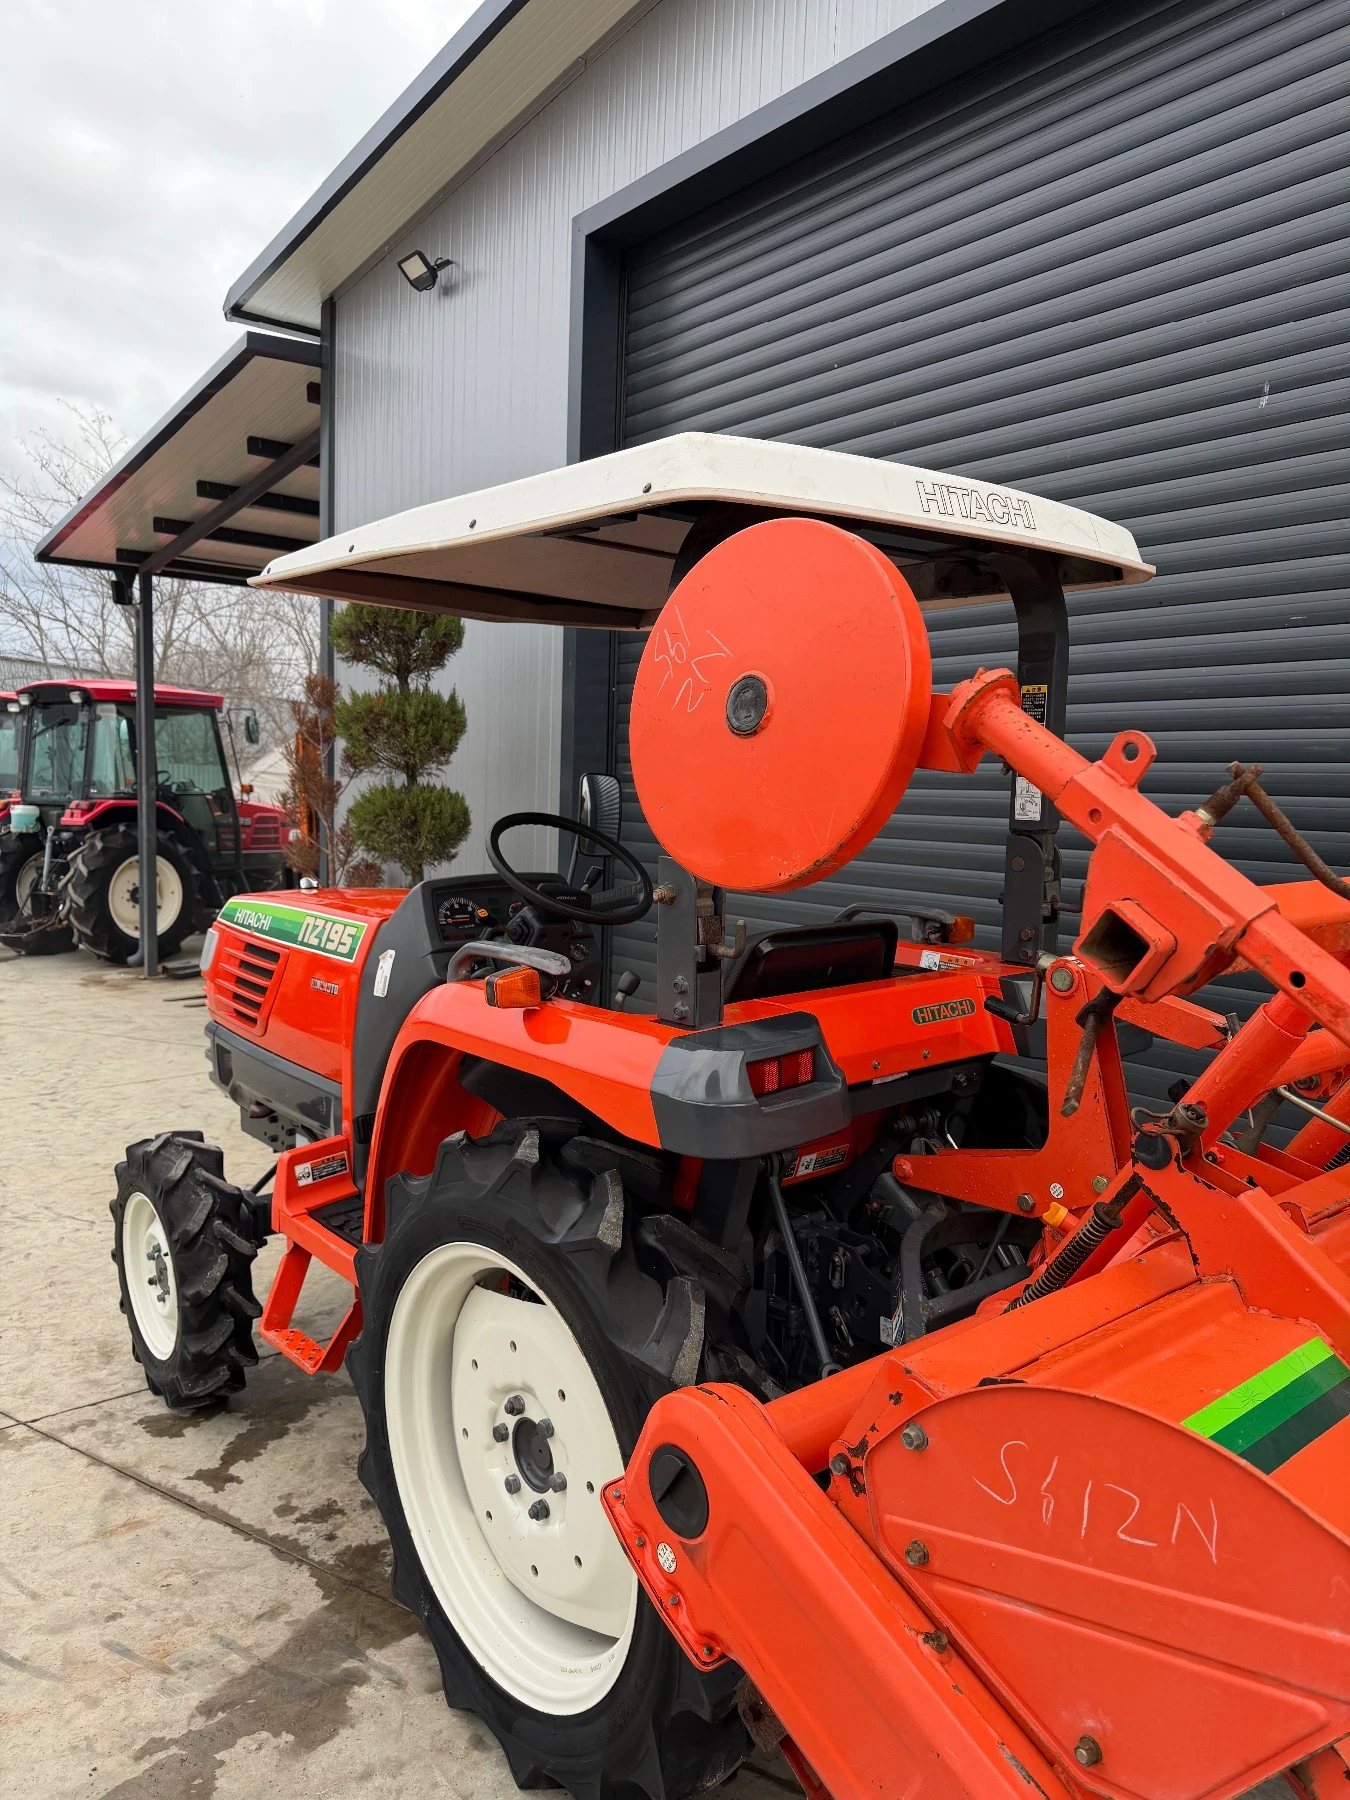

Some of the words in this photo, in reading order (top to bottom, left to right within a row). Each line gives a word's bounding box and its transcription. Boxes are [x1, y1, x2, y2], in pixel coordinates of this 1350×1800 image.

[916, 480, 1036, 529] HITACHI
[233, 908, 273, 931] HITACHI
[916, 999, 972, 1023] HITACHI
